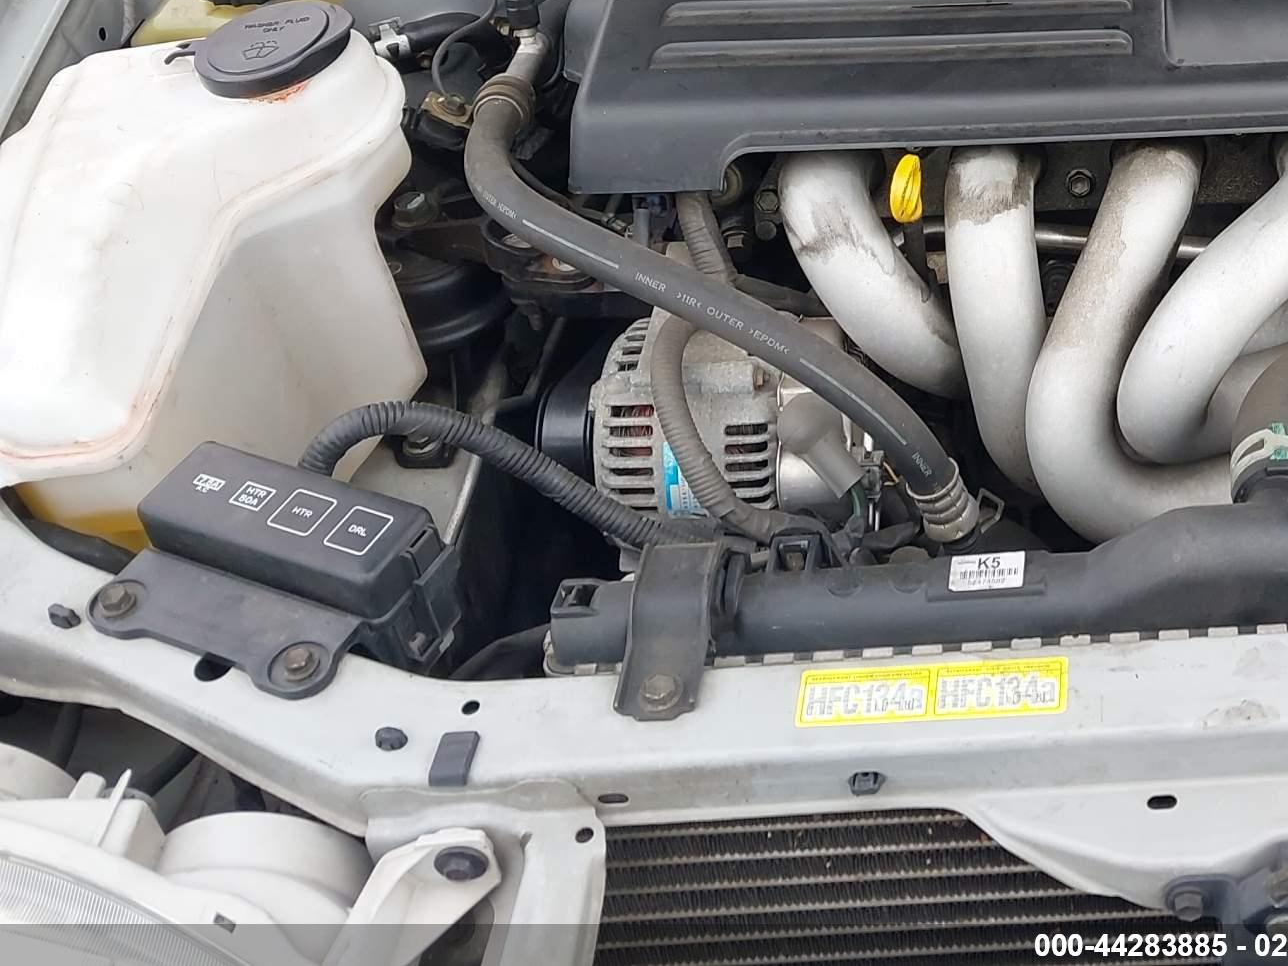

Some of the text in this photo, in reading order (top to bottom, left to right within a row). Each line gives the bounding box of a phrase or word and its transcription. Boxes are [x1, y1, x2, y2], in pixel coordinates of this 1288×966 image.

[634, 271, 667, 293] INNER
[706, 306, 745, 331] OUTER
[245, 486, 268, 498] HTR
[291, 506, 313, 519] HTR
[347, 524, 368, 538] DRL
[977, 556, 1001, 570] K5
